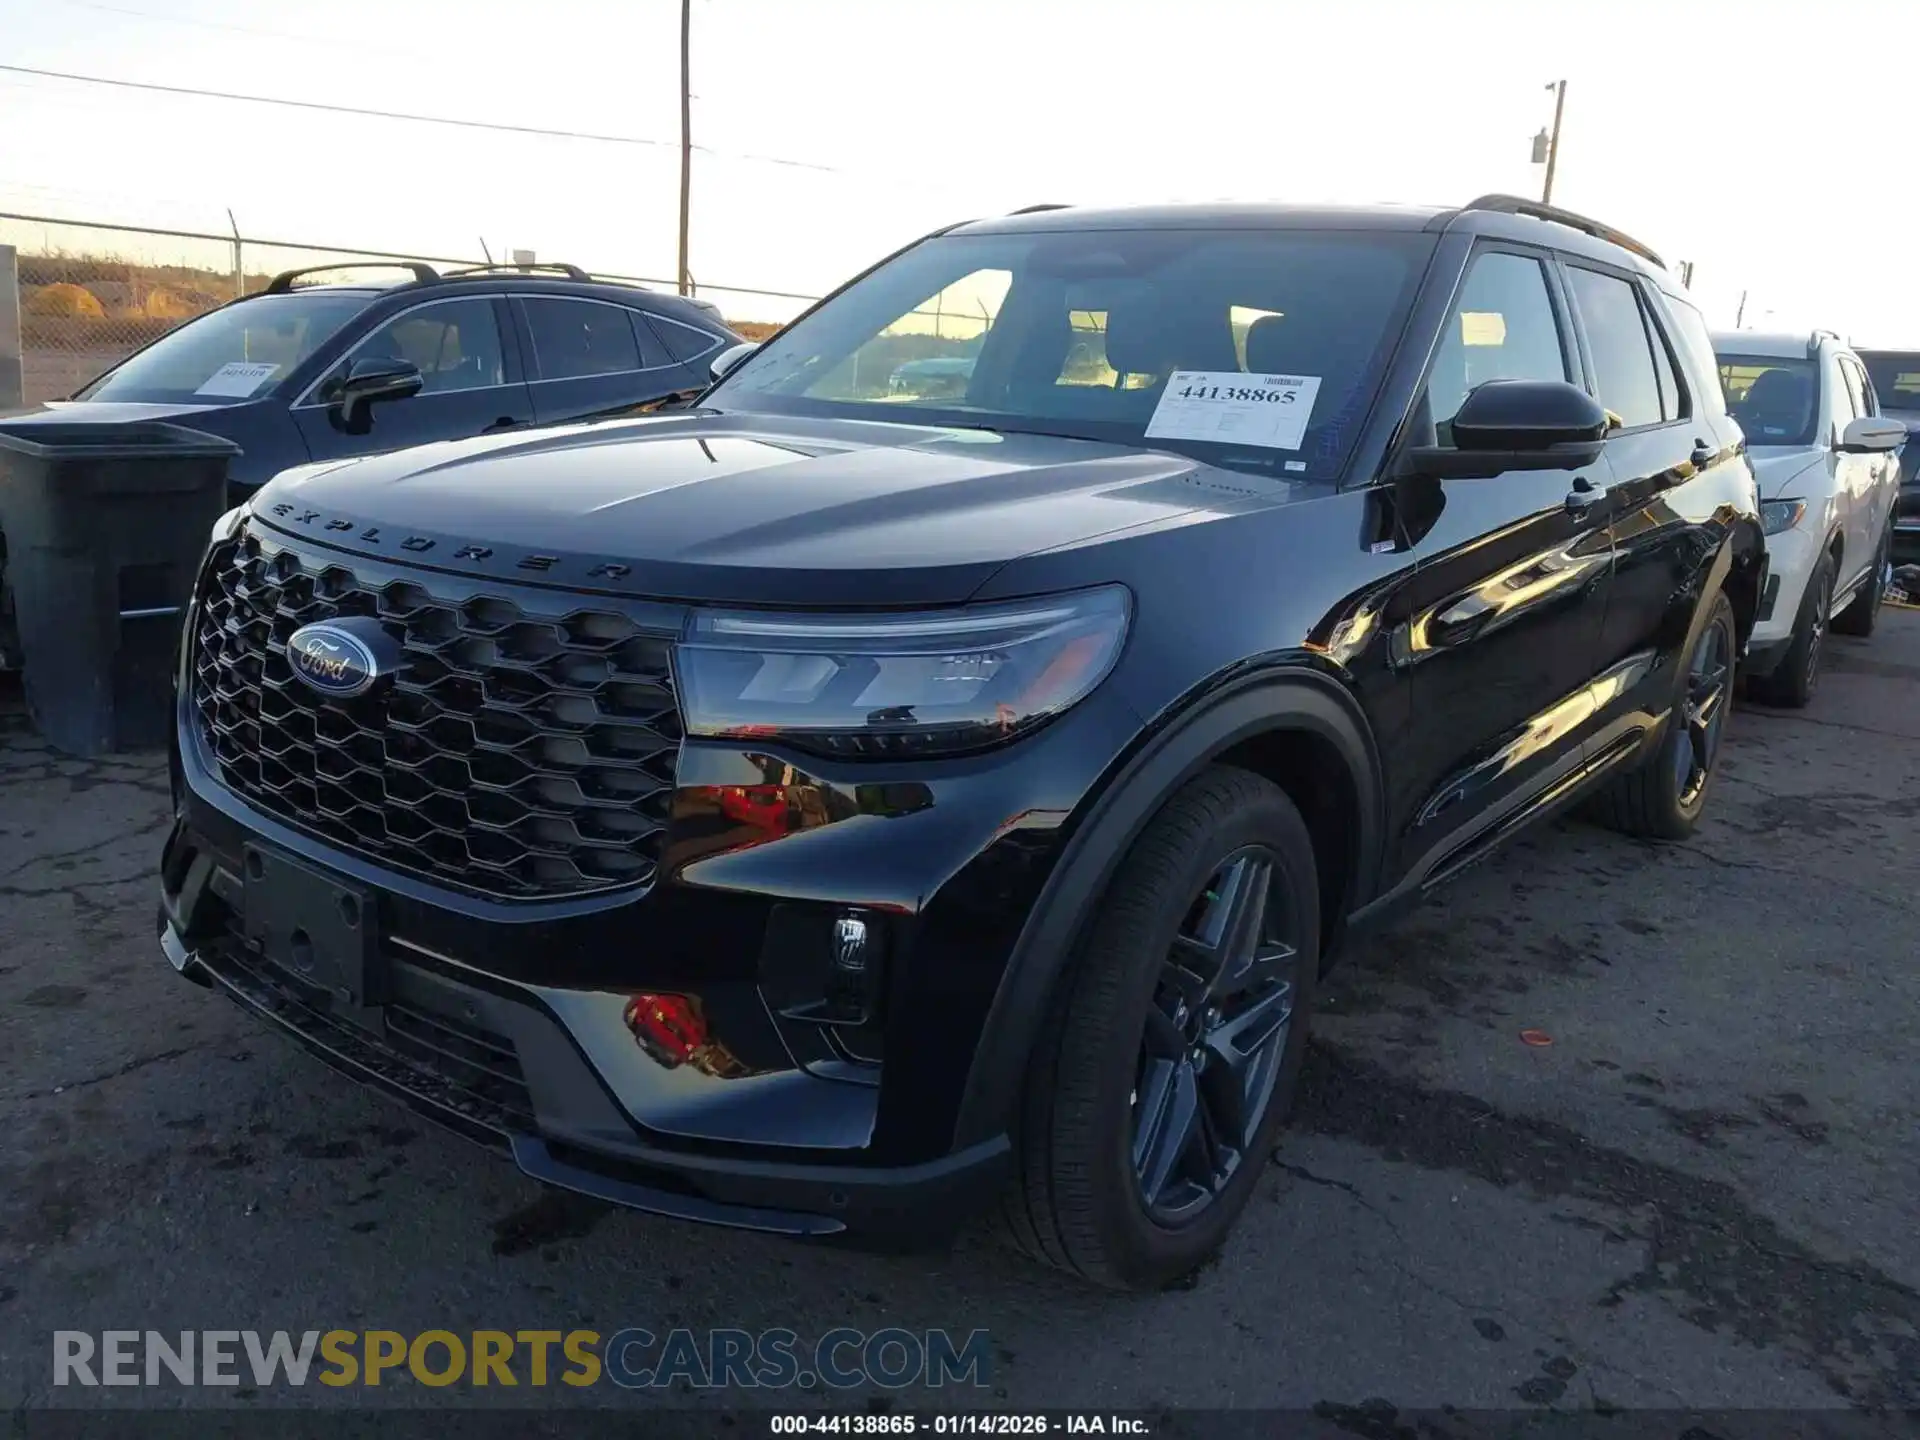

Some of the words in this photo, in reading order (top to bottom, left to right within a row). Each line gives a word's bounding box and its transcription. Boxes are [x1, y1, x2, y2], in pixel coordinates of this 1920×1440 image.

[1178, 385, 1296, 404] 44138865
[272, 503, 632, 581] EXPLORER
[300, 638, 350, 681] Ford
